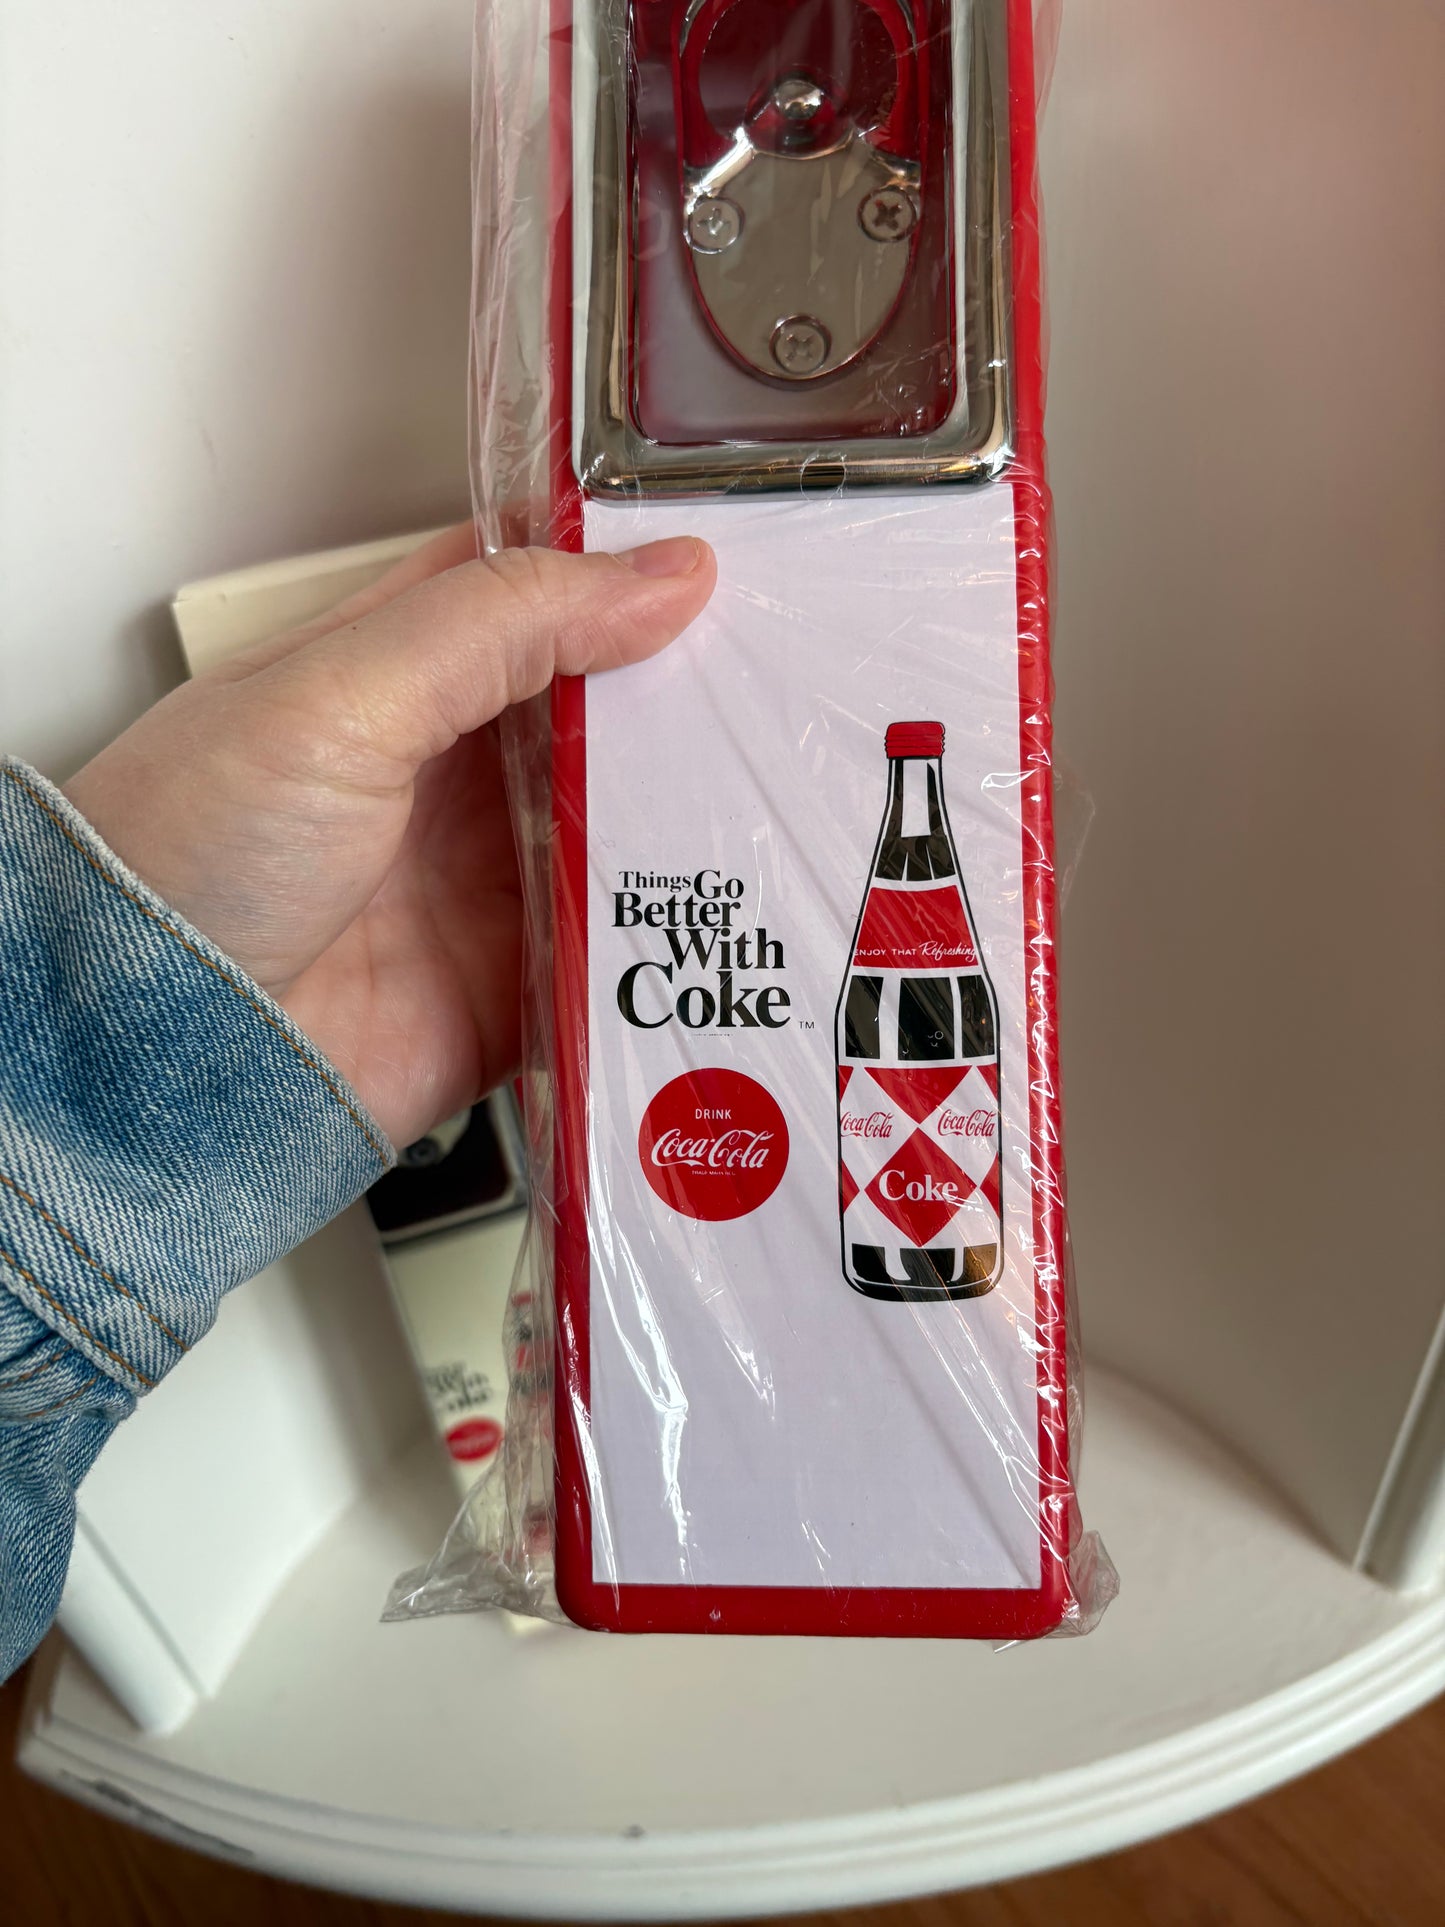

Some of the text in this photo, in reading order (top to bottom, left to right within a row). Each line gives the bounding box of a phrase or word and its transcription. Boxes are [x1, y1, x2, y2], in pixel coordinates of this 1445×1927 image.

[618, 869, 745, 900] Things Go
[611, 891, 742, 928] Better
[662, 927, 787, 970] With
[854, 940, 977, 963] ENJOY THAT Refreshing
[616, 961, 815, 1030] Coke TM
[695, 1108, 732, 1120] DRINK
[937, 1108, 997, 1137] Coca-Cola
[651, 1128, 775, 1168] Coca-Cola
[878, 1169, 959, 1201] Coke
